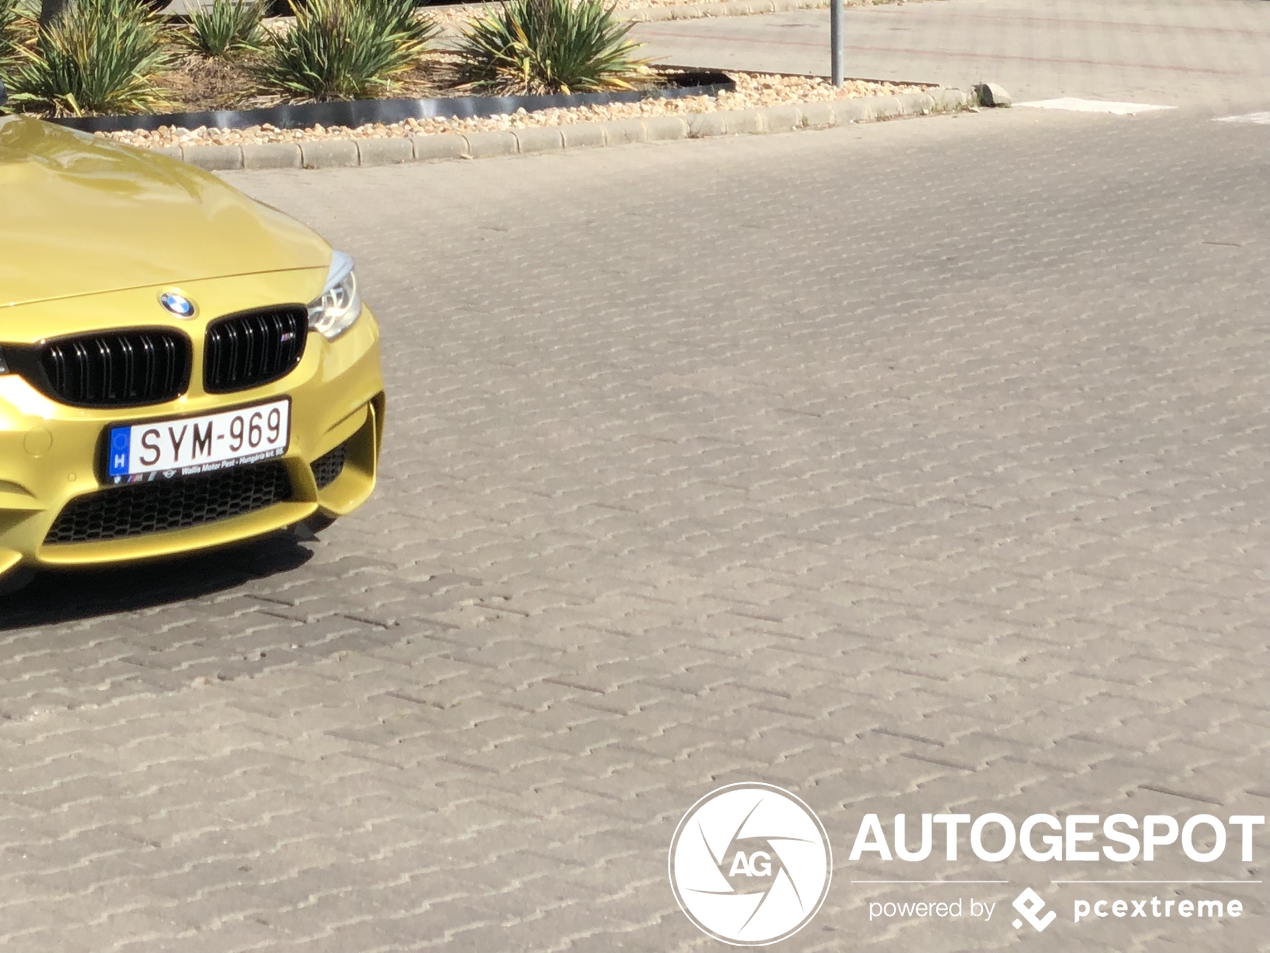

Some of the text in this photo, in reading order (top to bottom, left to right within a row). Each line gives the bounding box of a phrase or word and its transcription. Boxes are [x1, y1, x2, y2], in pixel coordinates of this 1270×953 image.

[139, 407, 281, 466] SYM-969
[114, 453, 125, 469] H
[202, 463, 221, 472] Motor
